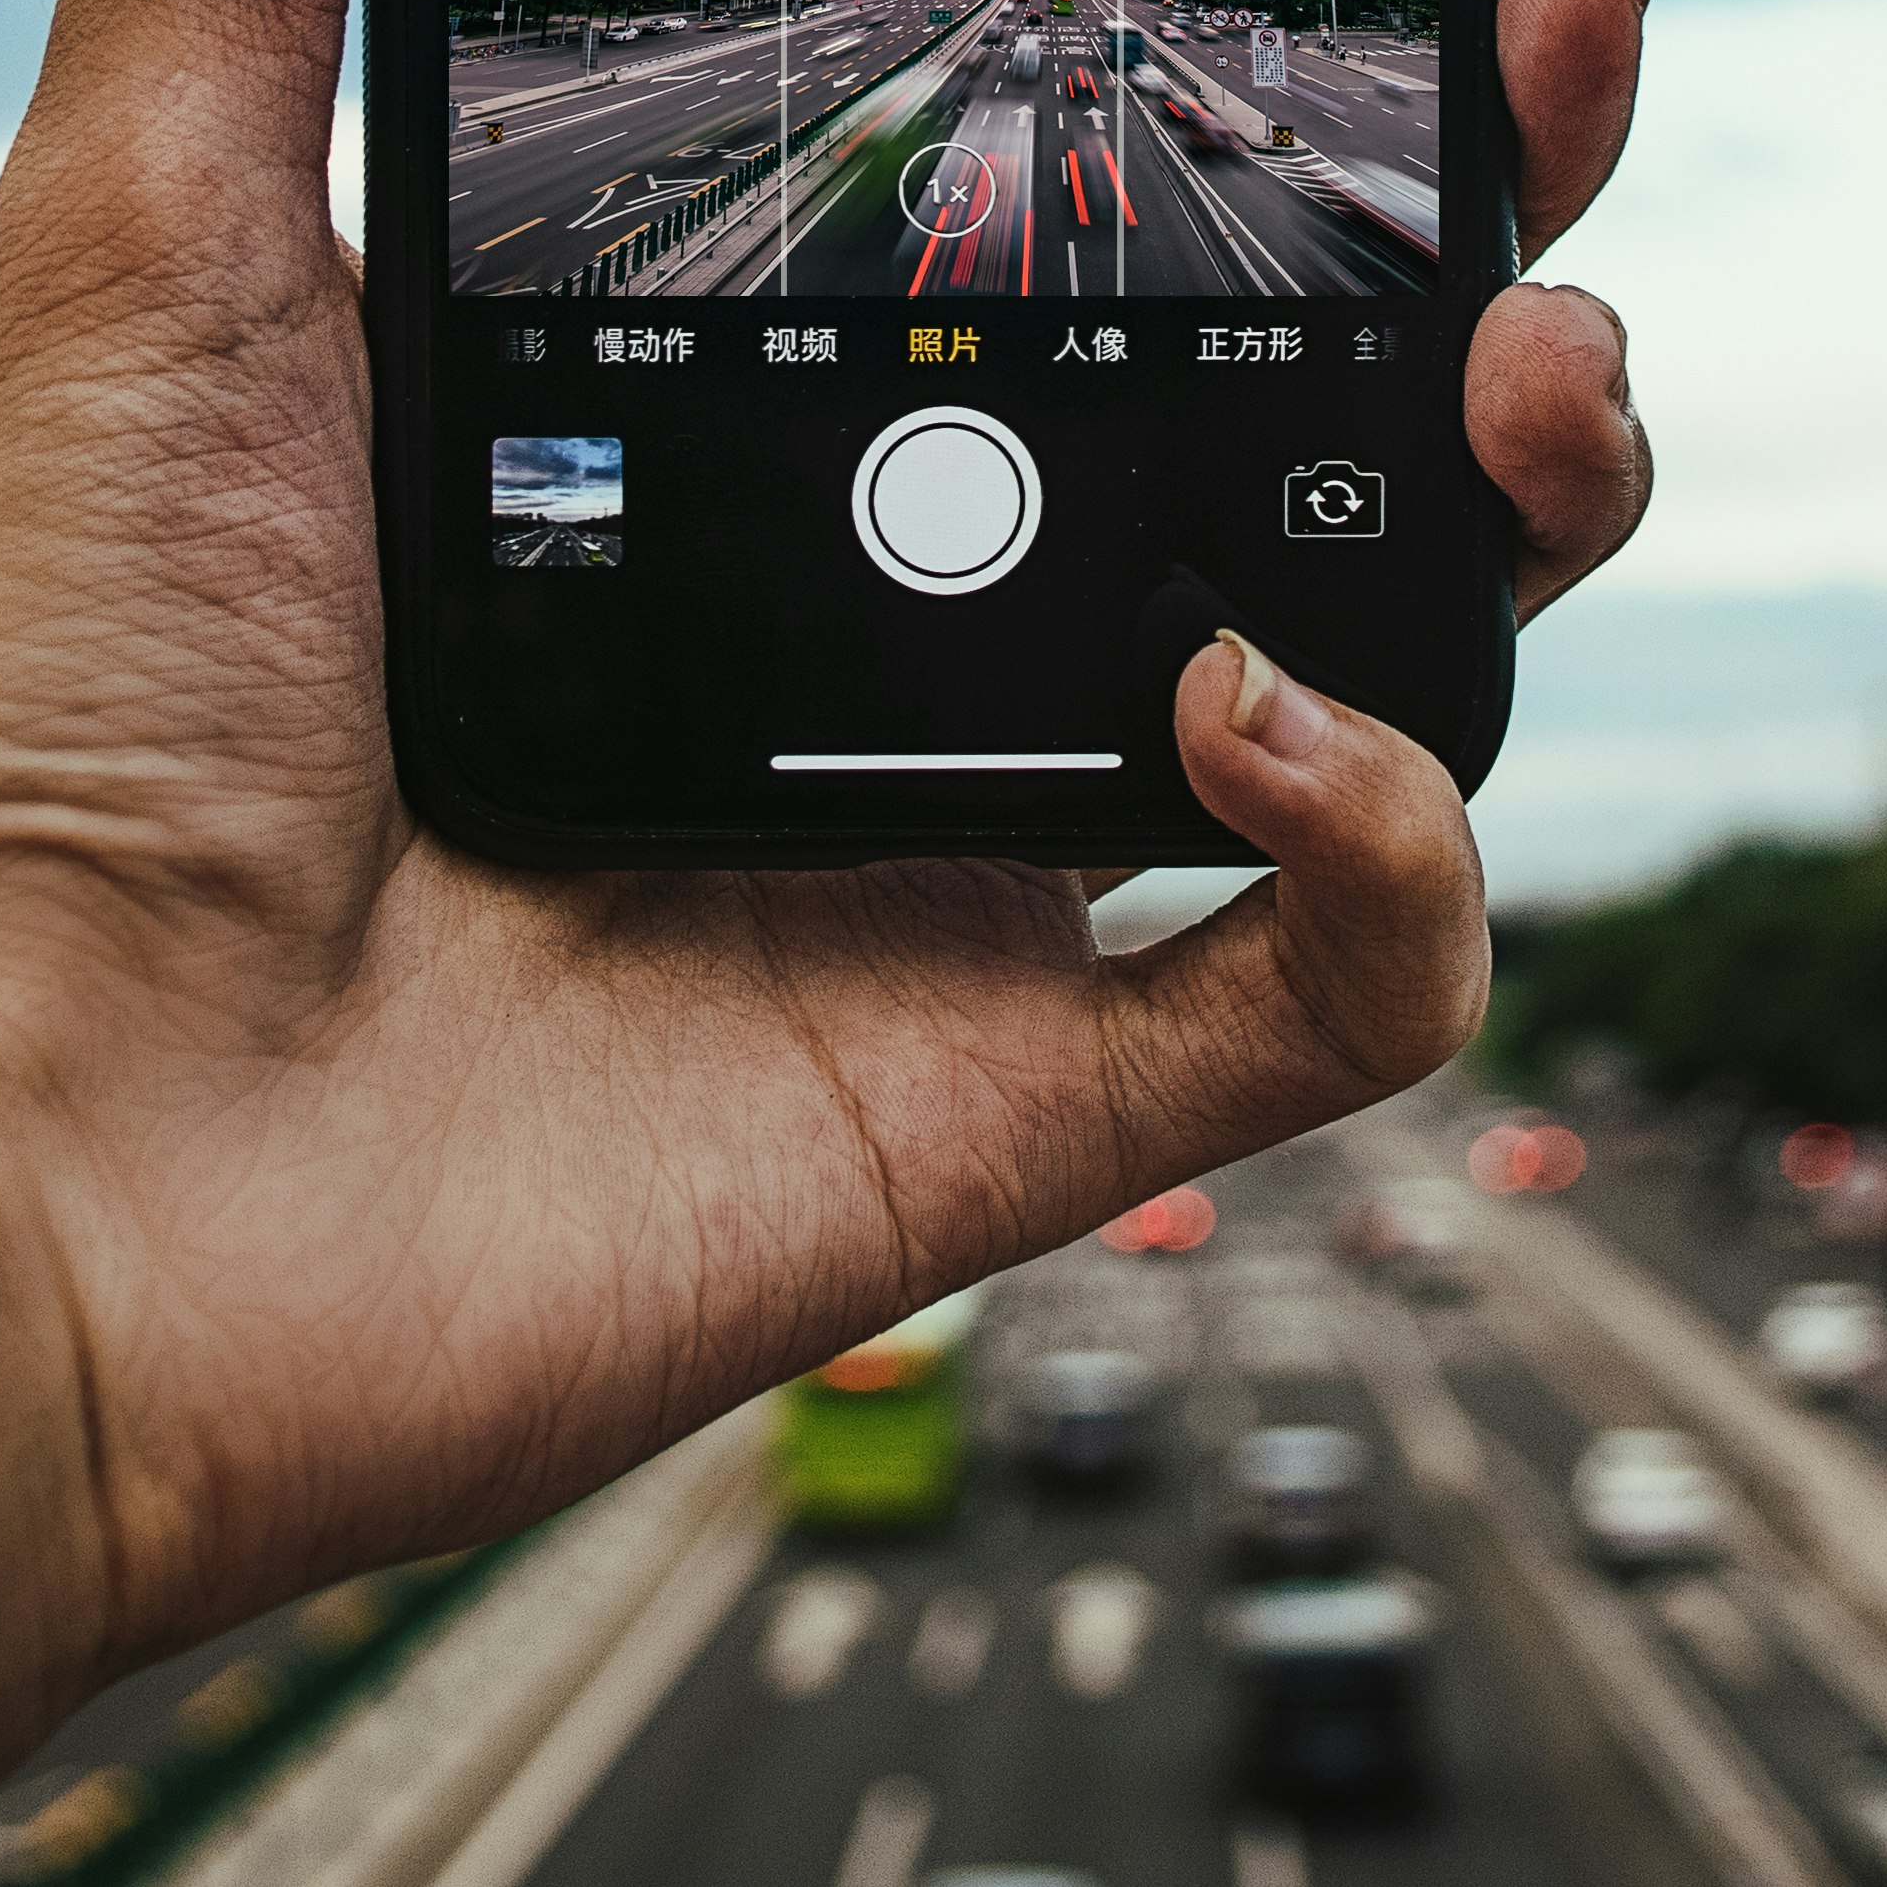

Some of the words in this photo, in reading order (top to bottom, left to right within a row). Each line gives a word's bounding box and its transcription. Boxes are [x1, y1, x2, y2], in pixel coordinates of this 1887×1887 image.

[926, 178, 969, 205] 1x
[594, 327, 696, 363] 慢动作
[761, 327, 838, 363] 视频
[909, 326, 982, 363] 照片
[1053, 326, 1129, 362] 人像
[1196, 326, 1303, 362] 正方形
